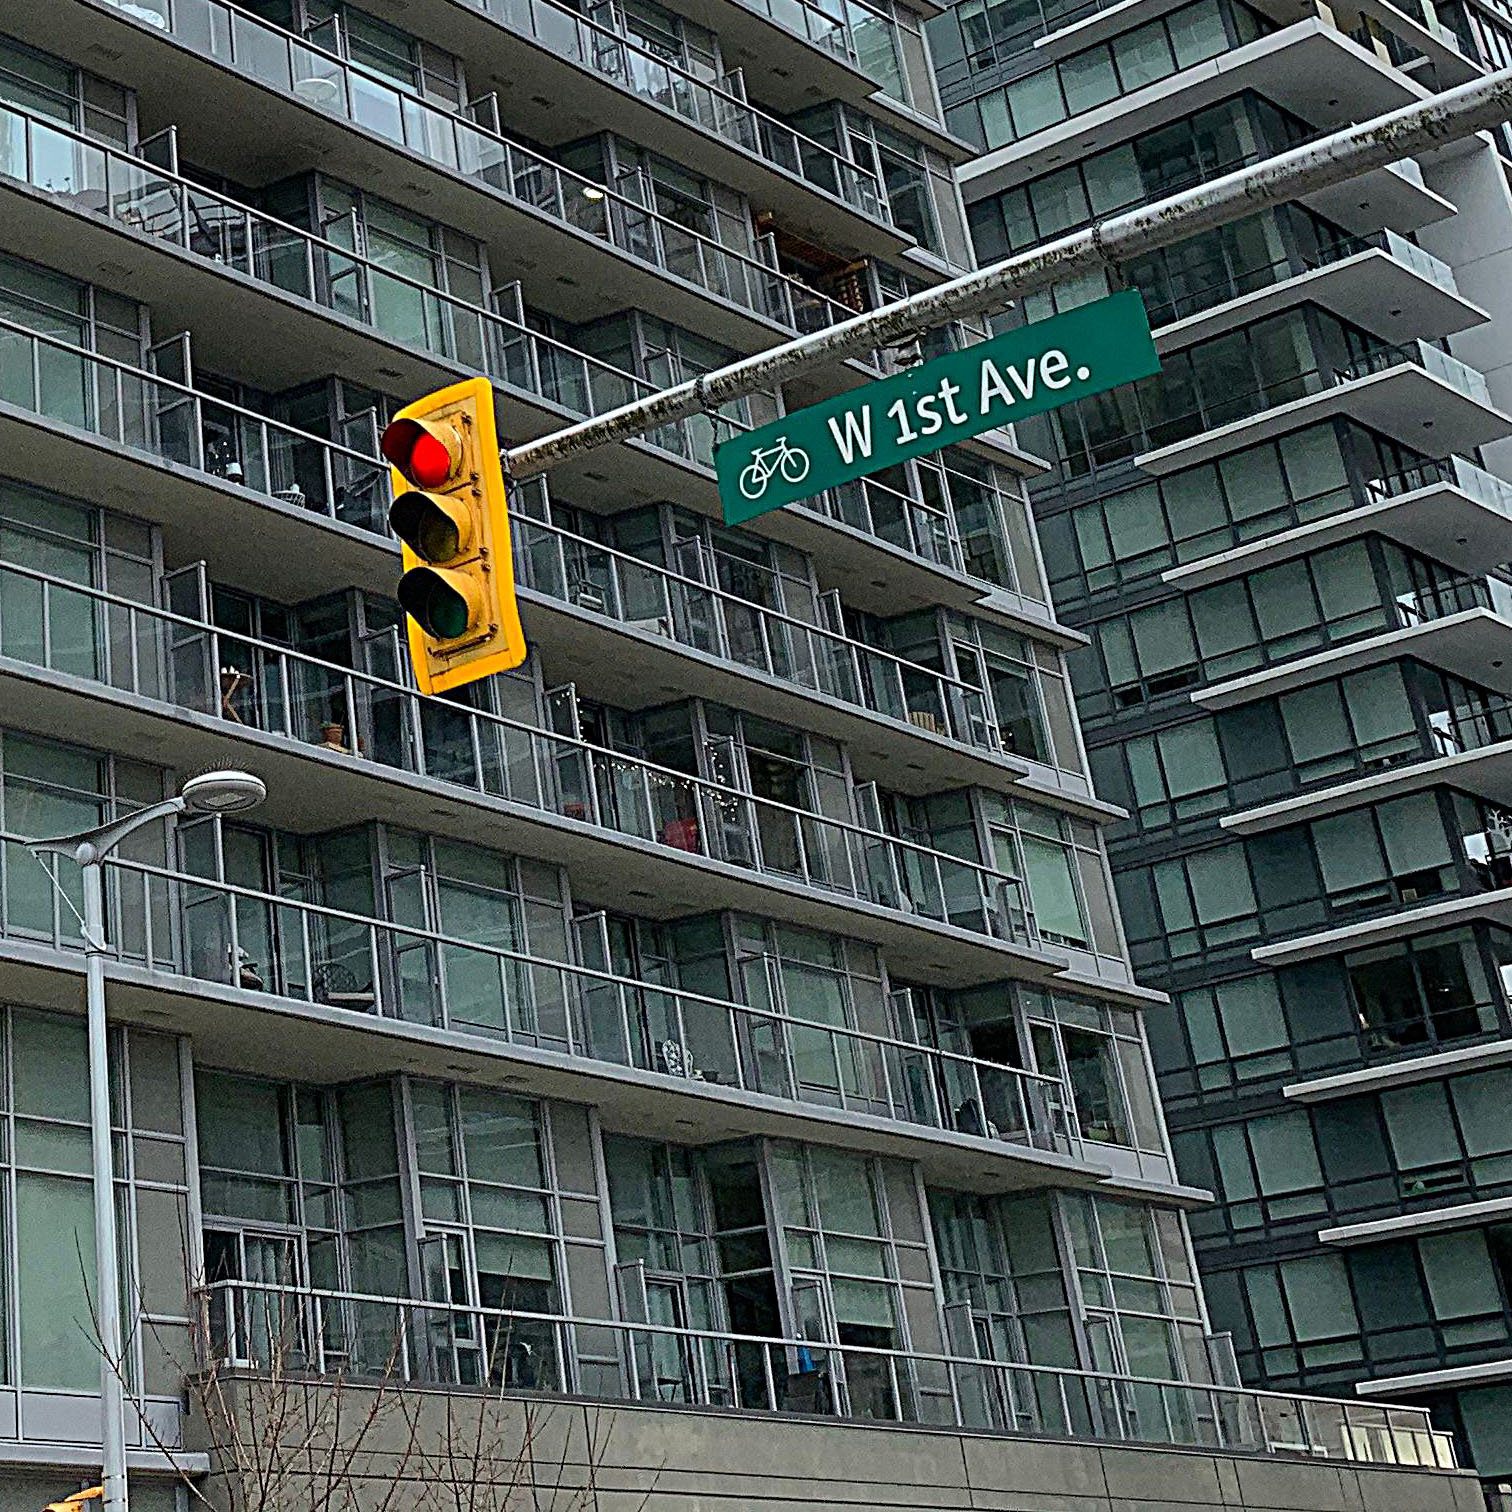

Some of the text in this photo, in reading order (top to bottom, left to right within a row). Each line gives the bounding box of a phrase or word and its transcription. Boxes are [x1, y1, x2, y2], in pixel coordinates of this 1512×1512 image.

[828, 349, 1090, 464] W 1st Ave.
